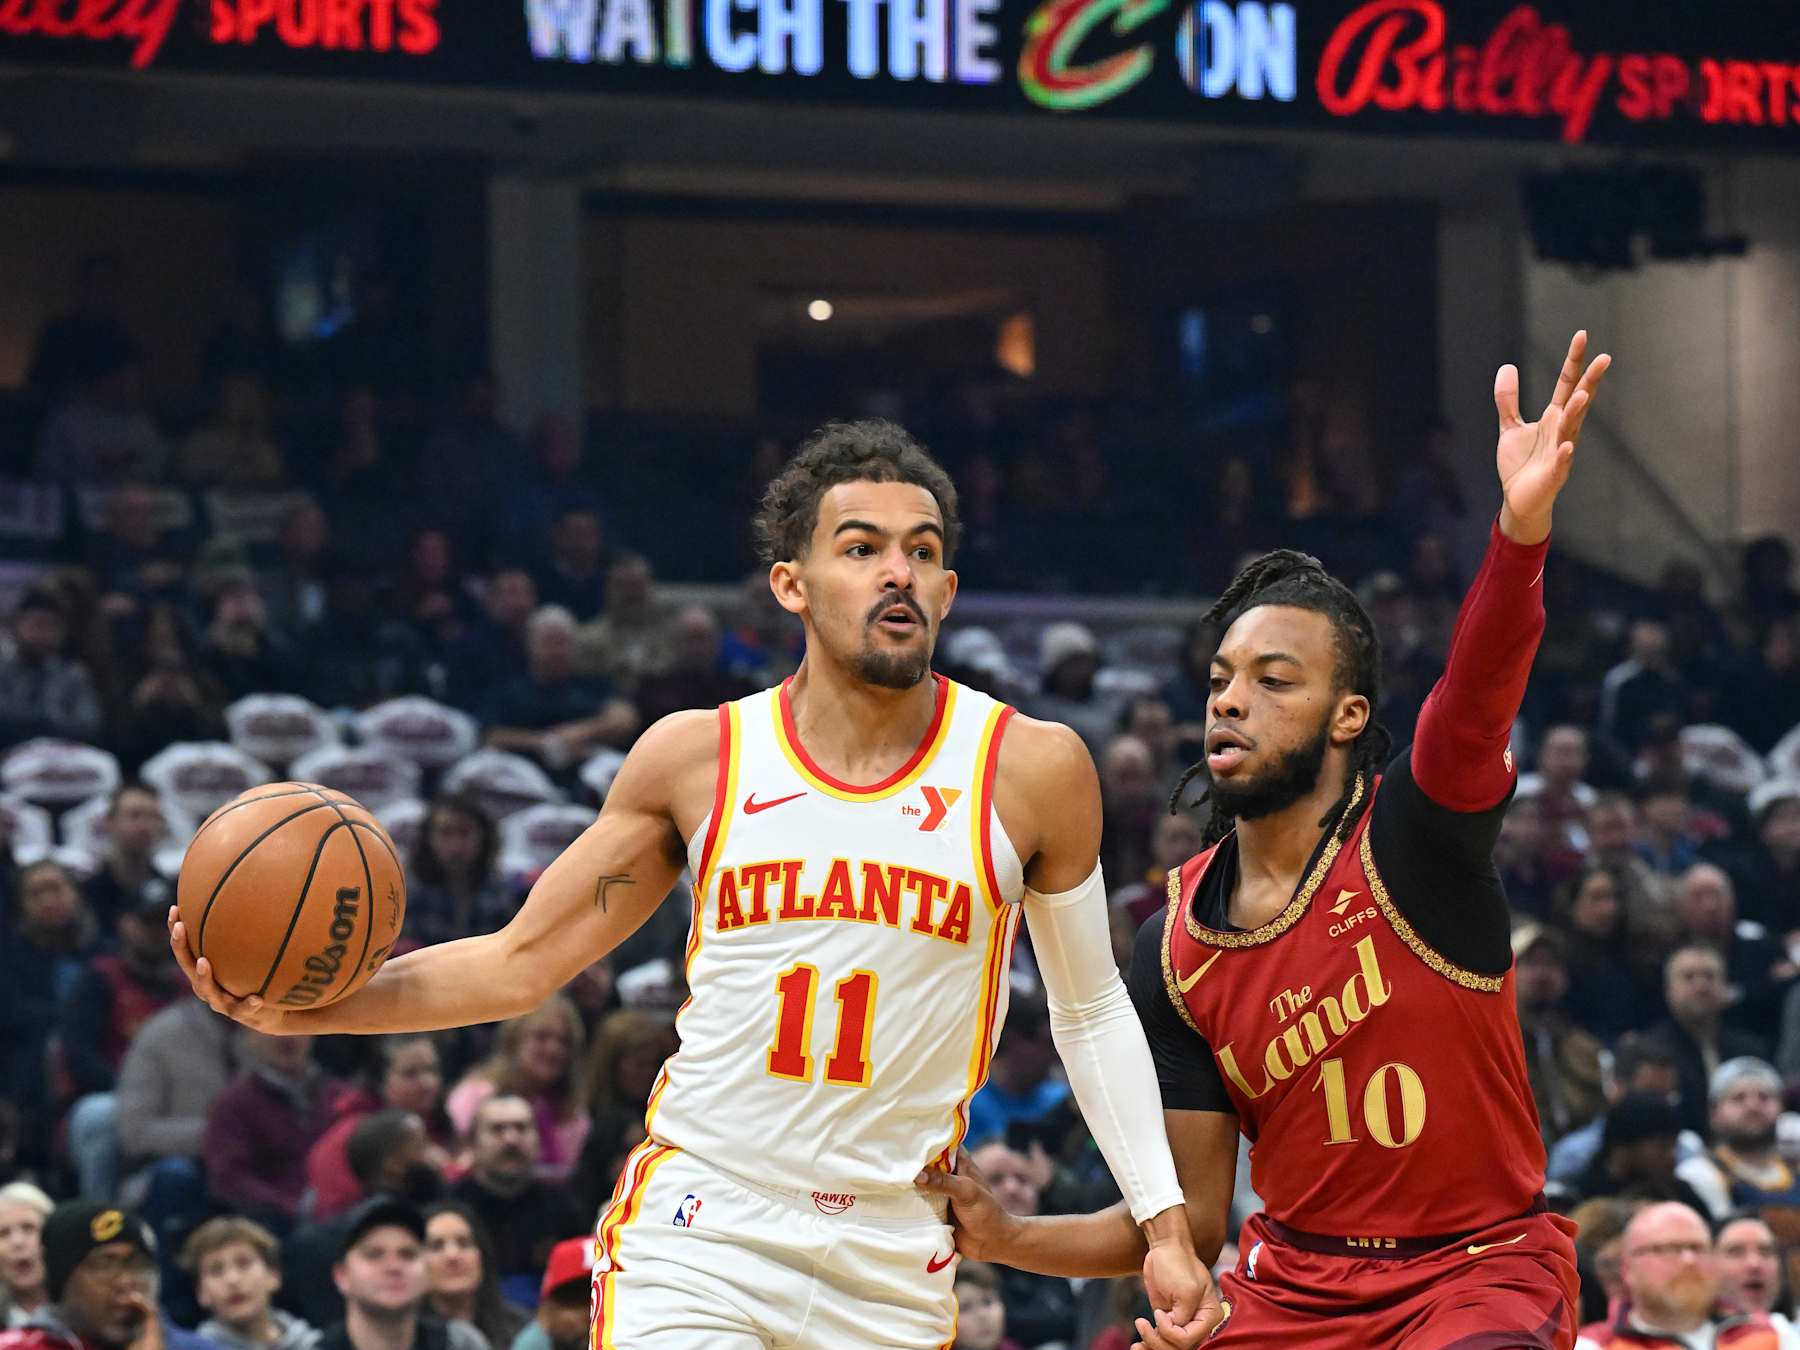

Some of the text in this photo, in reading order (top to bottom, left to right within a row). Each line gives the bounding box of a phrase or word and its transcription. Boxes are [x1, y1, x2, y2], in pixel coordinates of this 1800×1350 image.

[209, 0, 441, 55] SPORTS
[524, 0, 823, 77] WATCH
[842, 0, 1000, 84] THE
[1176, 0, 1297, 102] ON
[901, 804, 921, 816] the
[716, 858, 973, 946] ATLANTA
[1328, 906, 1378, 938] CLIFFS
[766, 962, 879, 1088] 11
[1216, 934, 1392, 1100] Land
[1269, 983, 1313, 1024] The
[1312, 1057, 1427, 1149] 10
